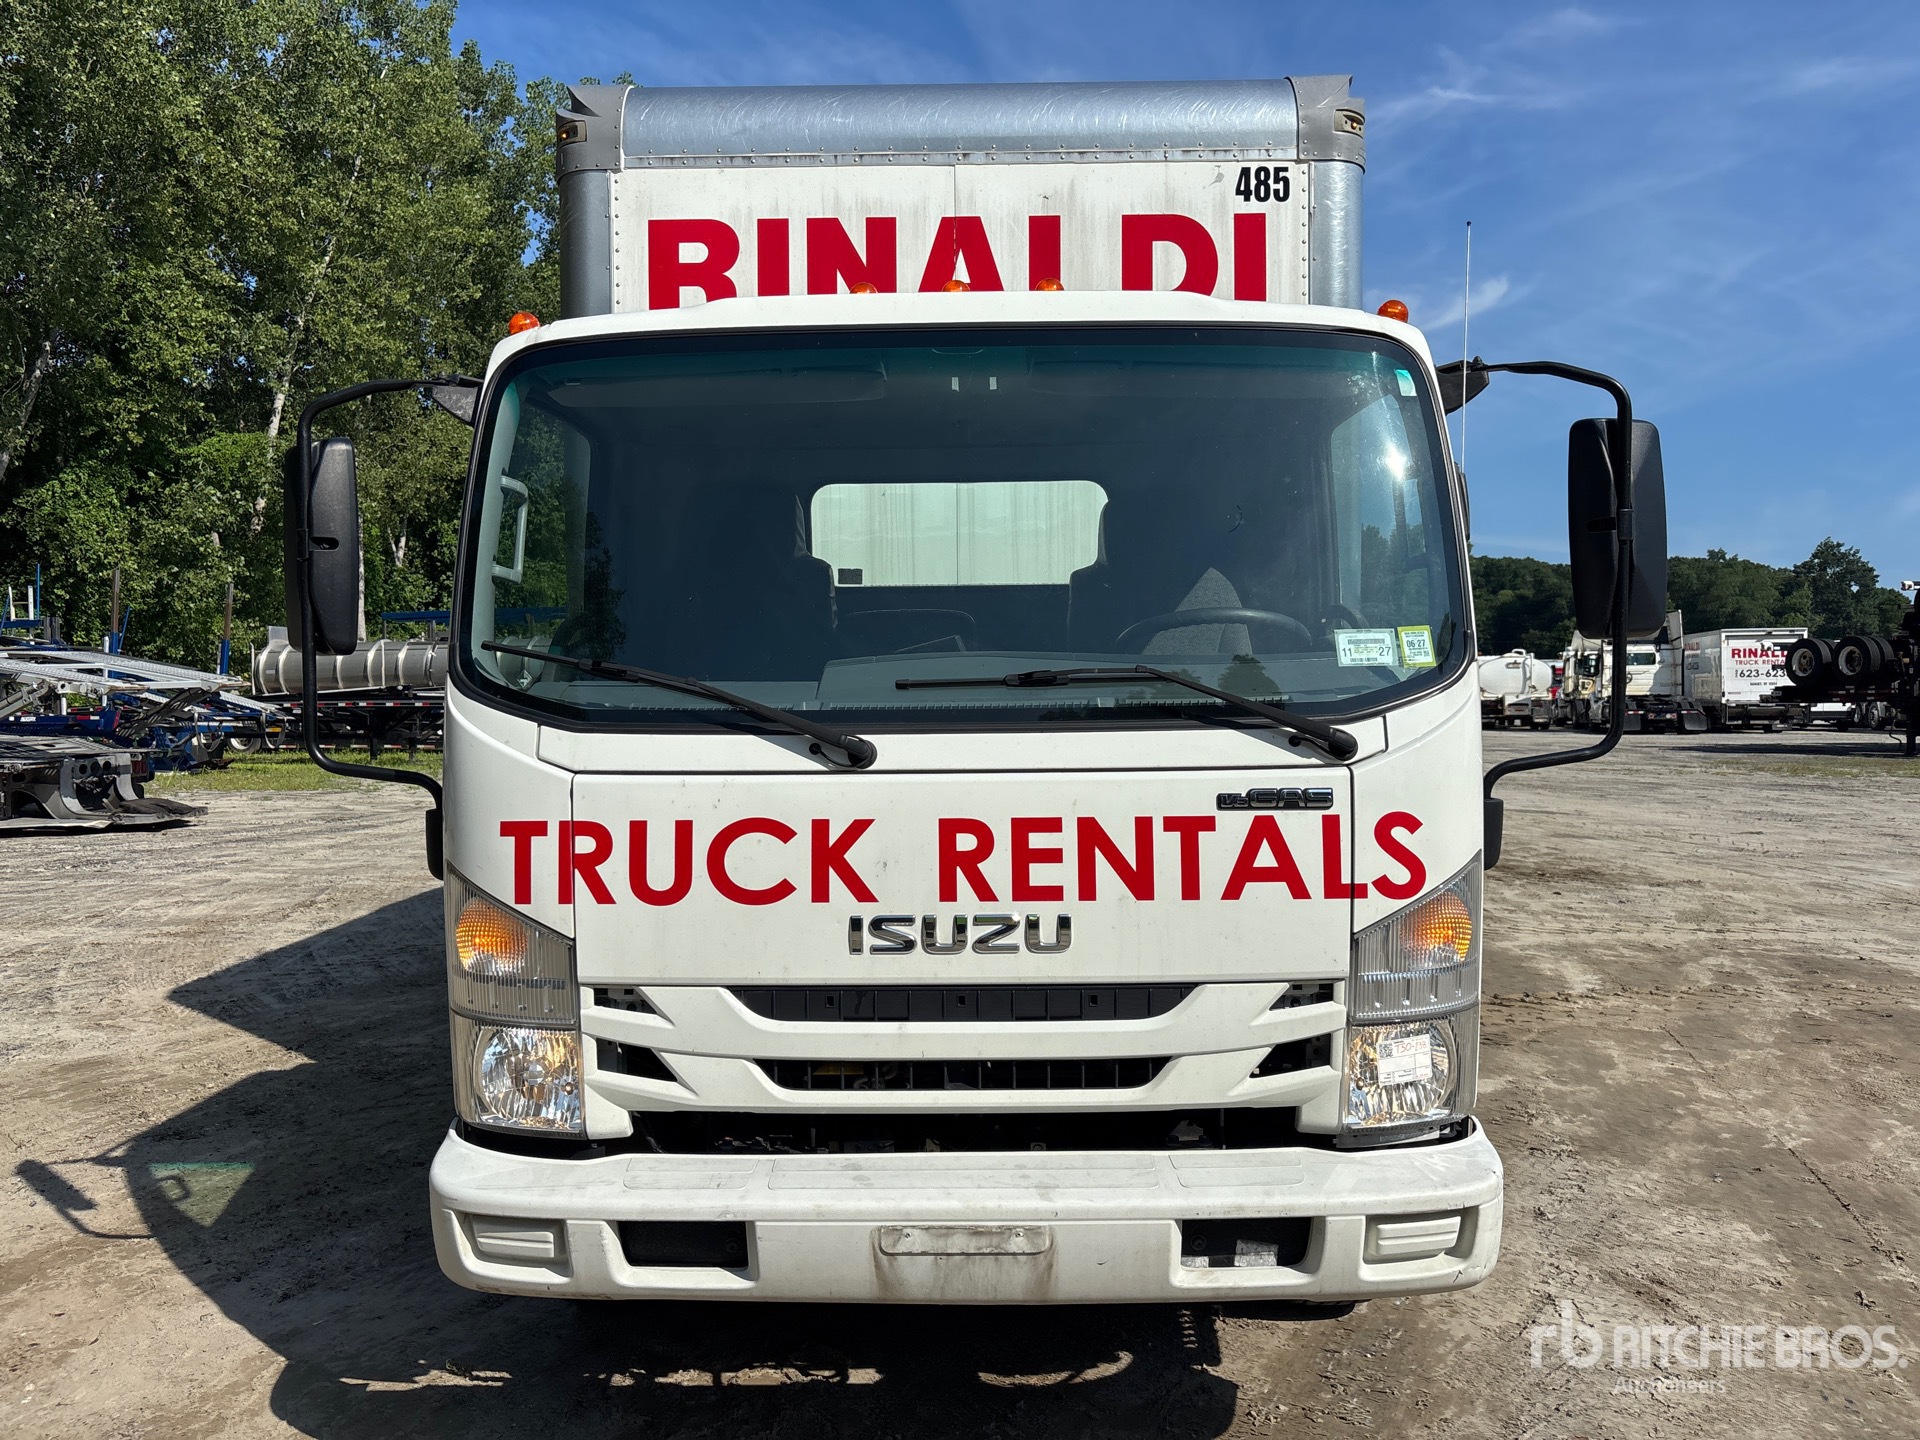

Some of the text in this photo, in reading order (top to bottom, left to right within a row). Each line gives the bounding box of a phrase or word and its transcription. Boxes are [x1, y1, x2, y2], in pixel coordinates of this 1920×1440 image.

[1235, 166, 1290, 202] 485
[1416, 639, 1426, 648] 27
[1342, 647, 1353, 657] 11
[1379, 646, 1392, 656] 27
[1731, 648, 1788, 659] RINAL
[1739, 668, 1786, 678] 623-623
[500, 811, 1427, 907] TRUCK RENTALS
[848, 914, 1072, 955] ISUZU
